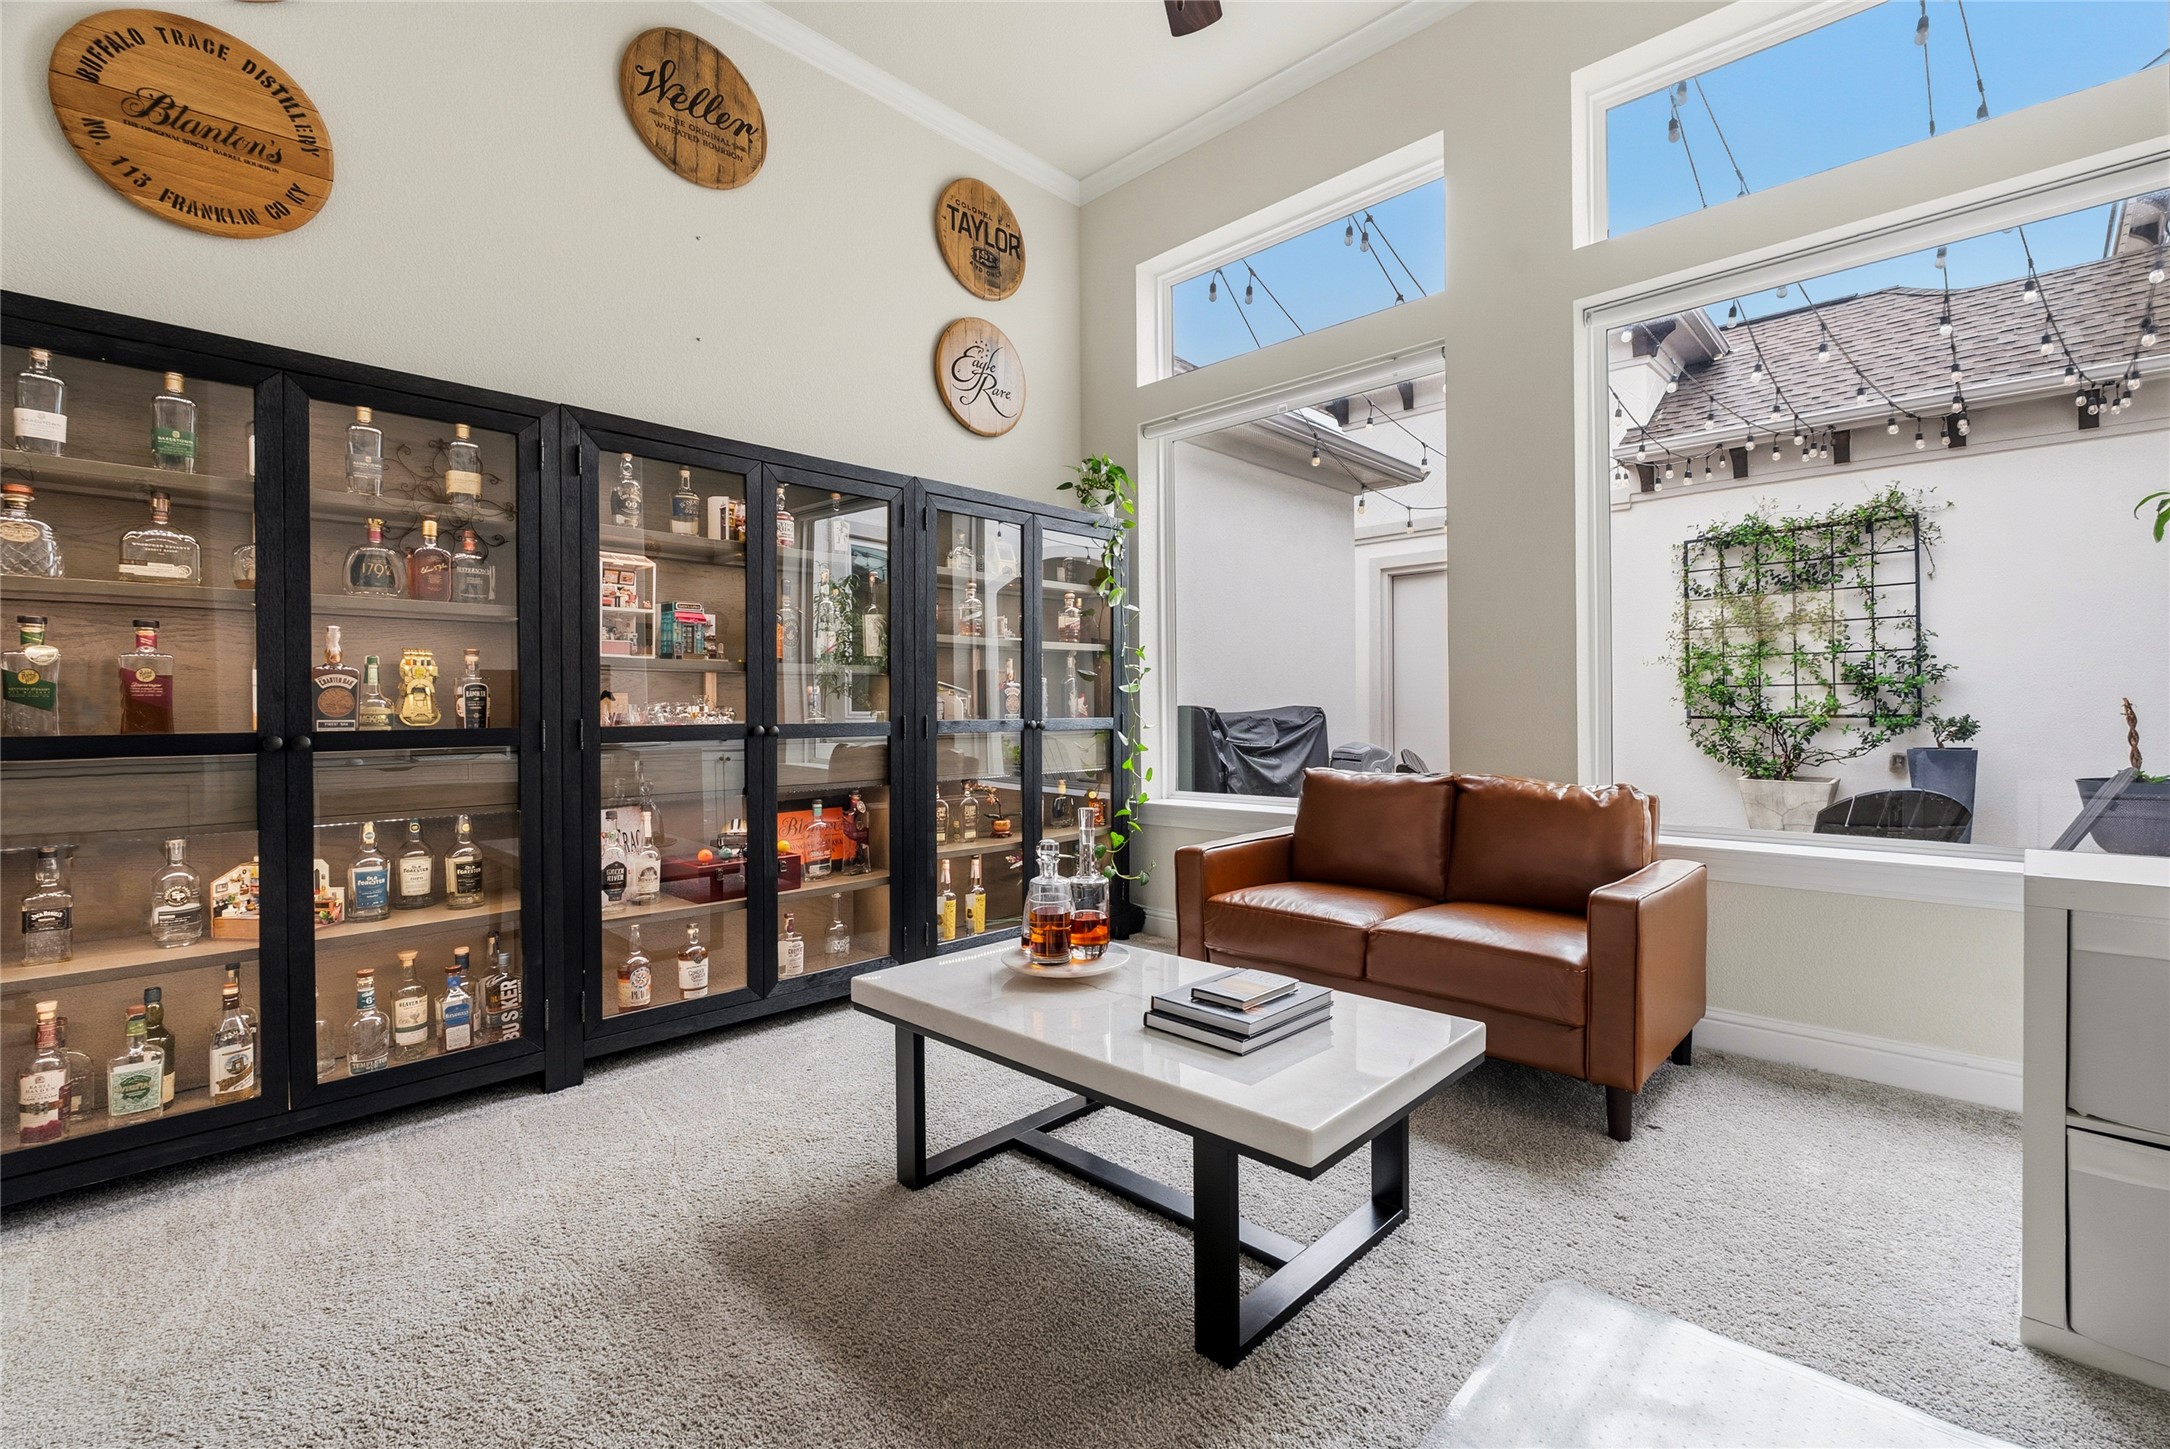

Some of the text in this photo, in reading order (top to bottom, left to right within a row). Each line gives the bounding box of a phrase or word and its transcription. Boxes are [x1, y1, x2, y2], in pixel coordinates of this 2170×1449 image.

[76, 26, 320, 157] BUFFALO TRACE DISTILLERY
[635, 60, 758, 137] Weller
[121, 87, 282, 163] Blanton's
[653, 120, 700, 143] WHEATED
[702, 140, 744, 163] BOURBON
[667, 114, 732, 147] THE ORIGINAL
[111, 154, 152, 187] 113
[159, 187, 260, 225] FRANKLIN
[264, 199, 291, 220] CO
[285, 182, 310, 205] KY
[955, 199, 993, 222] COLONEL
[946, 203, 1021, 261] TAYLOR
[970, 260, 983, 273] AND
[951, 345, 1004, 391] Eagle
[362, 562, 392, 578] 1792
[500, 978, 520, 1042] BUSKER
